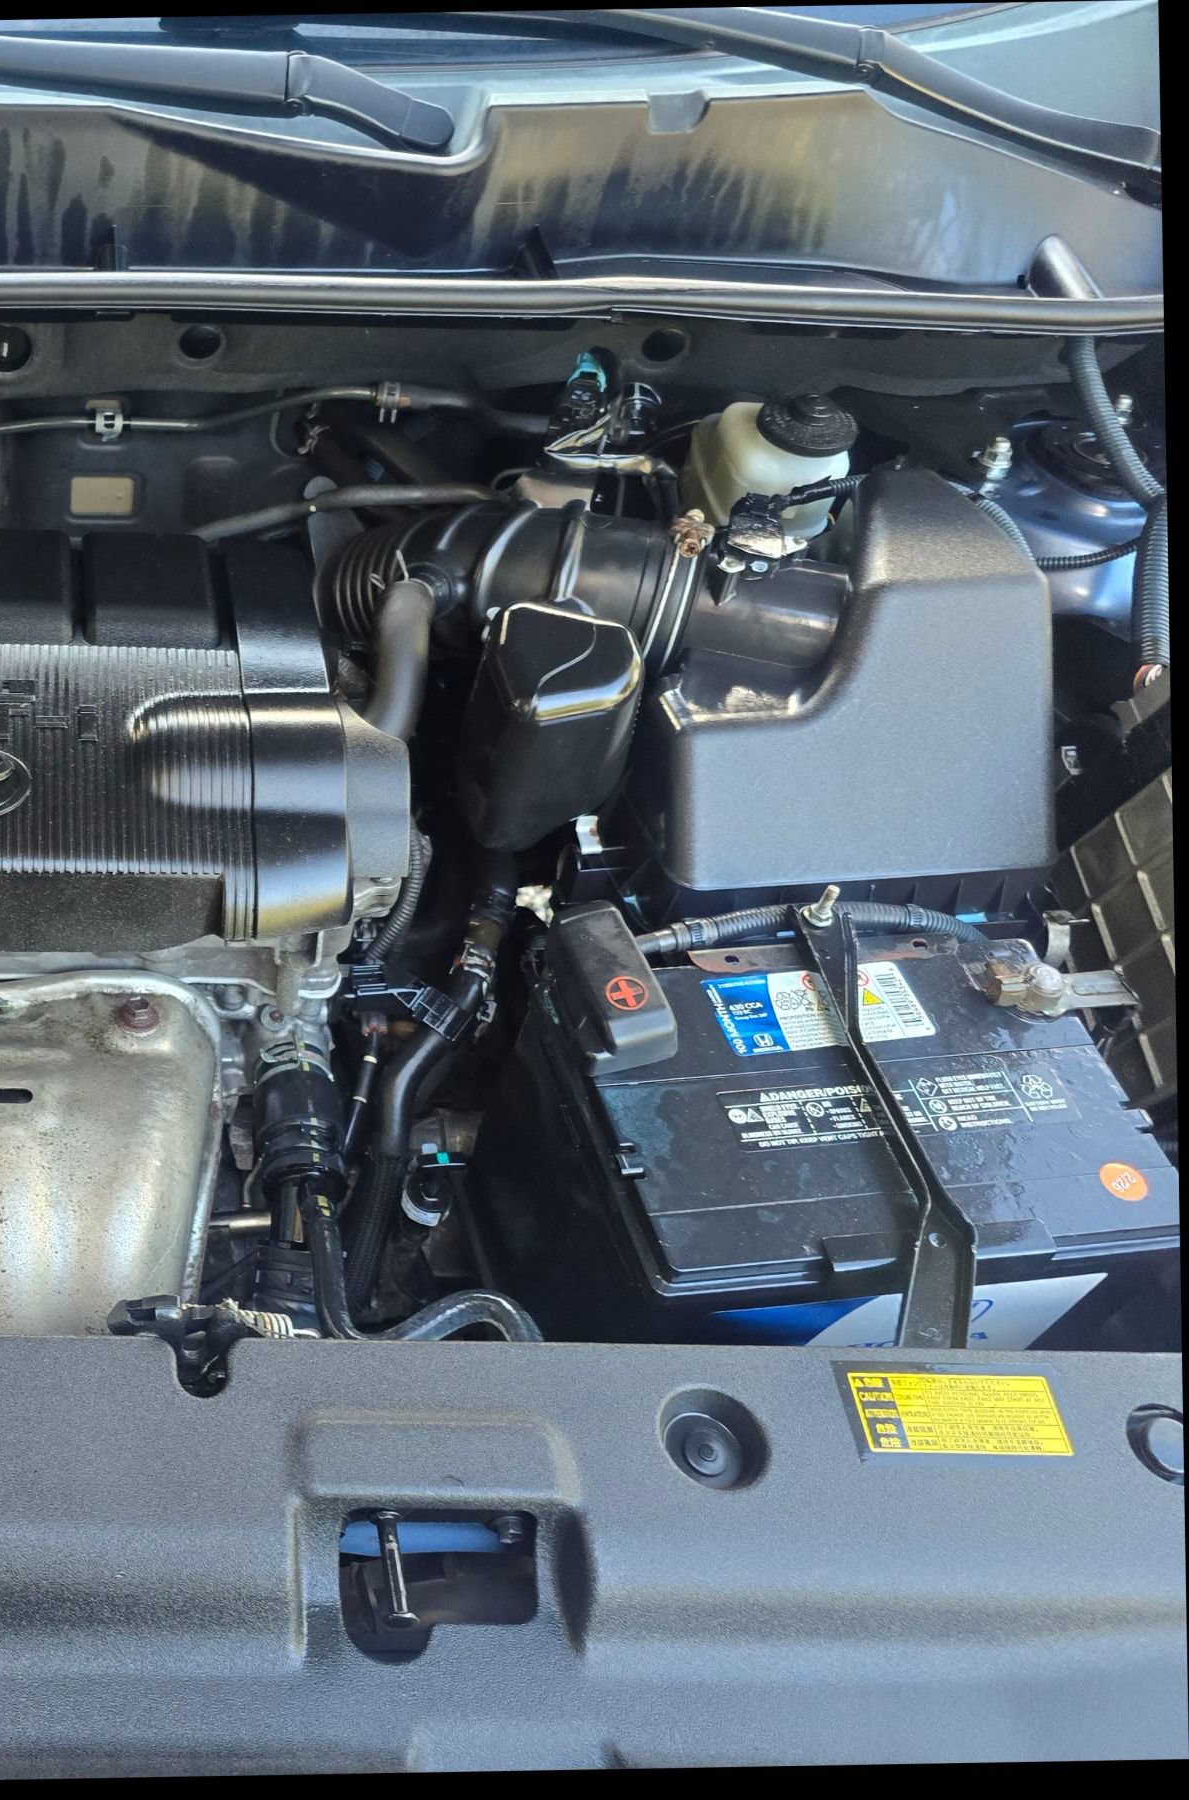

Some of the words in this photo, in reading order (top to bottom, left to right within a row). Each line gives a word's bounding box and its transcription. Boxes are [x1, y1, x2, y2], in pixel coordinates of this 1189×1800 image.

[746, 1001, 764, 1010] CCA
[714, 1003, 741, 1039] MONTH
[732, 1038, 749, 1055] 100
[771, 1139, 785, 1147] NOT
[838, 1133, 857, 1141] CAPS
[858, 1391, 894, 1401] CAUTION
